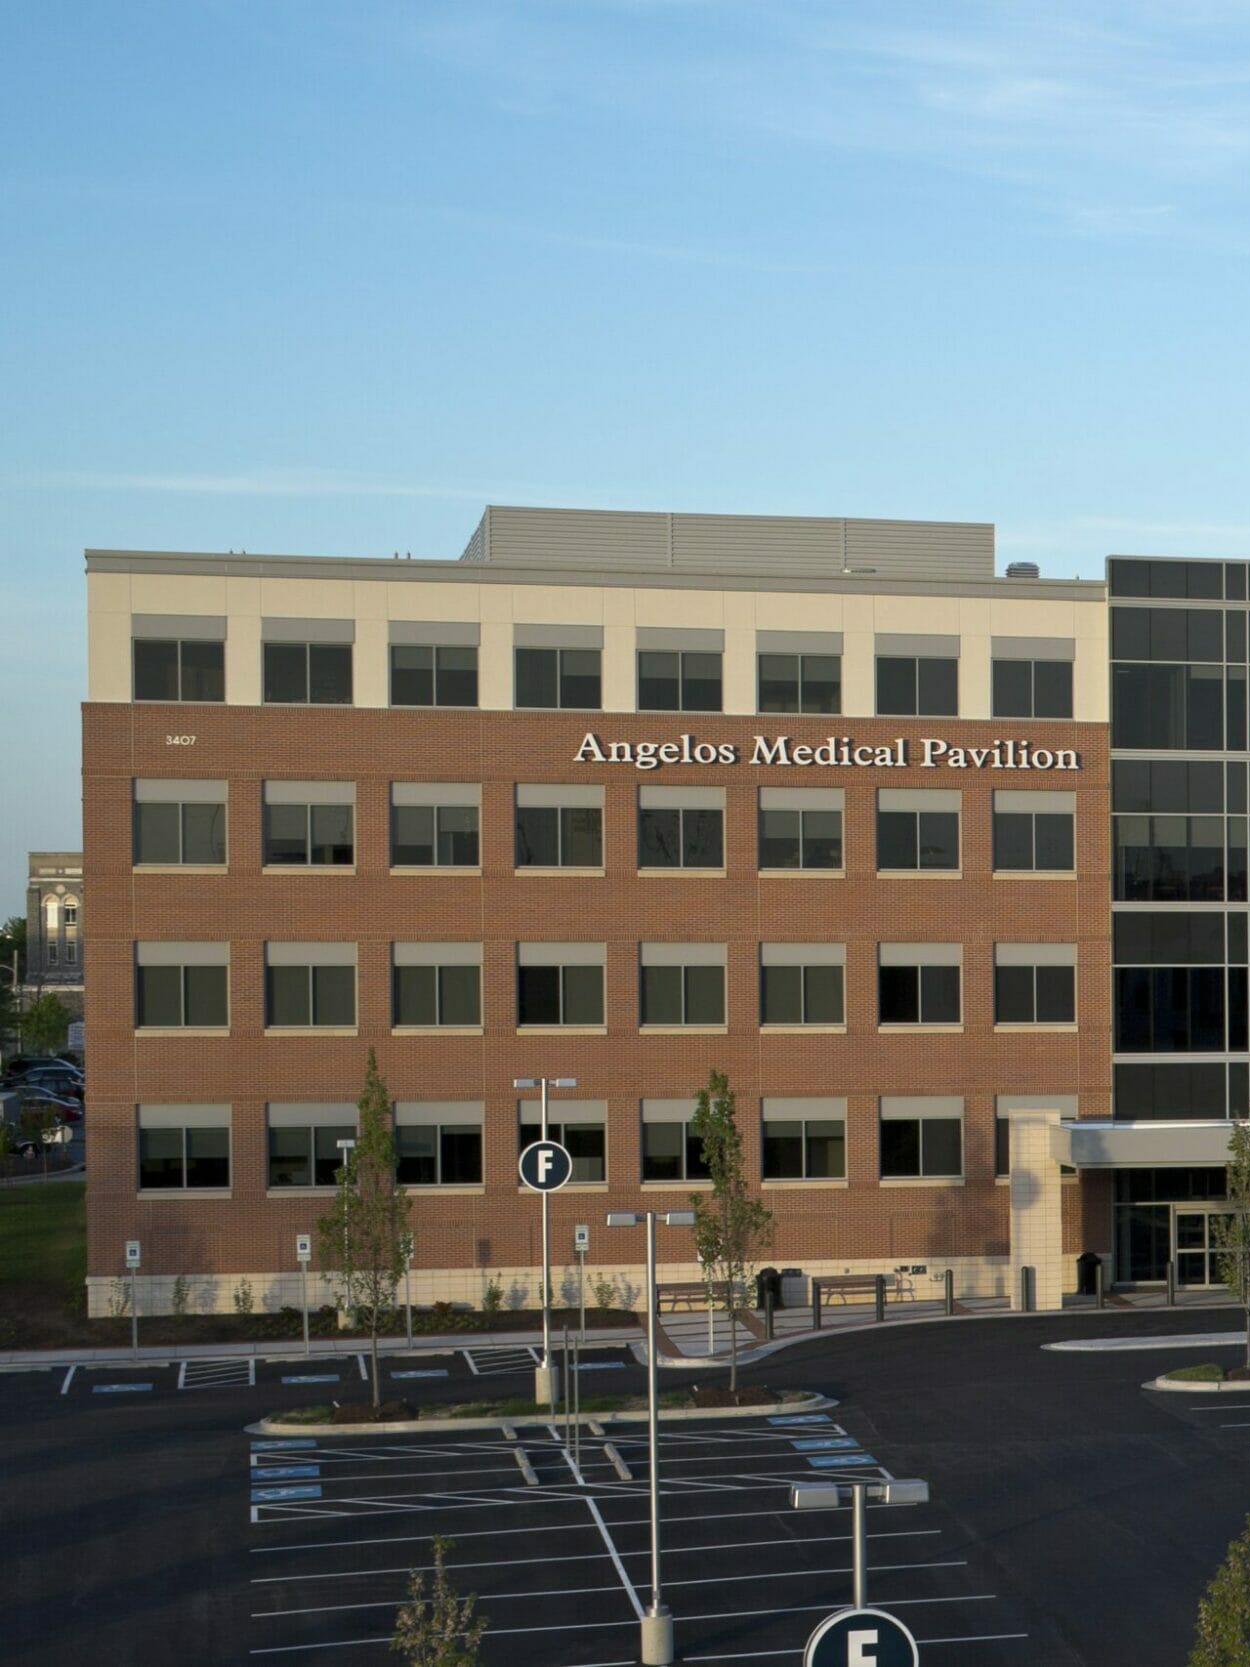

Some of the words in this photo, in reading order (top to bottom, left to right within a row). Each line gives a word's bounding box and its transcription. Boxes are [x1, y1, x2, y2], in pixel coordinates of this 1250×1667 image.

[165, 735, 197, 746] 3407
[573, 732, 736, 770] Angelos
[749, 735, 907, 767] Medical
[920, 738, 1080, 770] Pavilion
[537, 1150, 554, 1183] F
